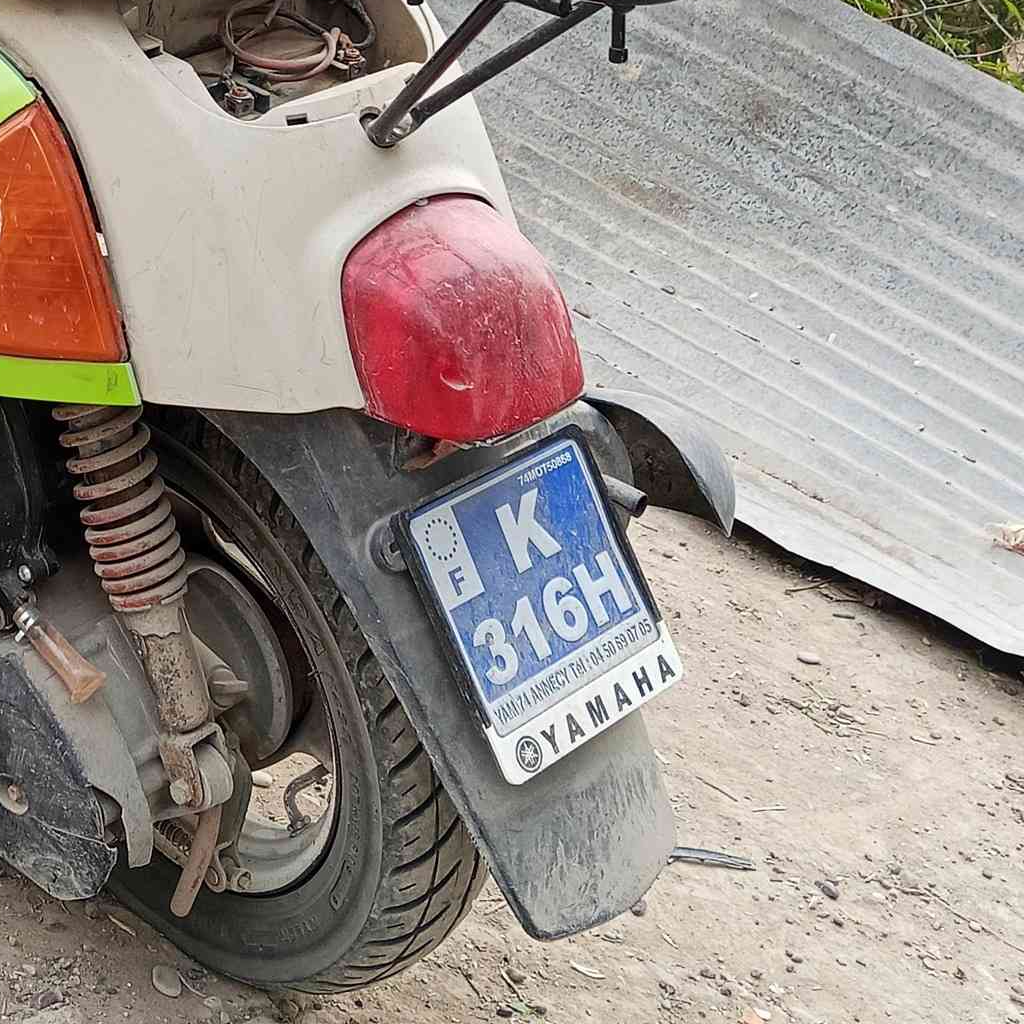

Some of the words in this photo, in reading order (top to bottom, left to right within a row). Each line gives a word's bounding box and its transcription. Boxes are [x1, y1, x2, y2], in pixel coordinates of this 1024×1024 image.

[495, 488, 562, 575] K
[447, 566, 464, 597] F
[472, 551, 634, 687] 316H
[530, 668, 570, 705] ANNECY
[627, 624, 641, 643] 07
[540, 653, 676, 755] YAMAHA
